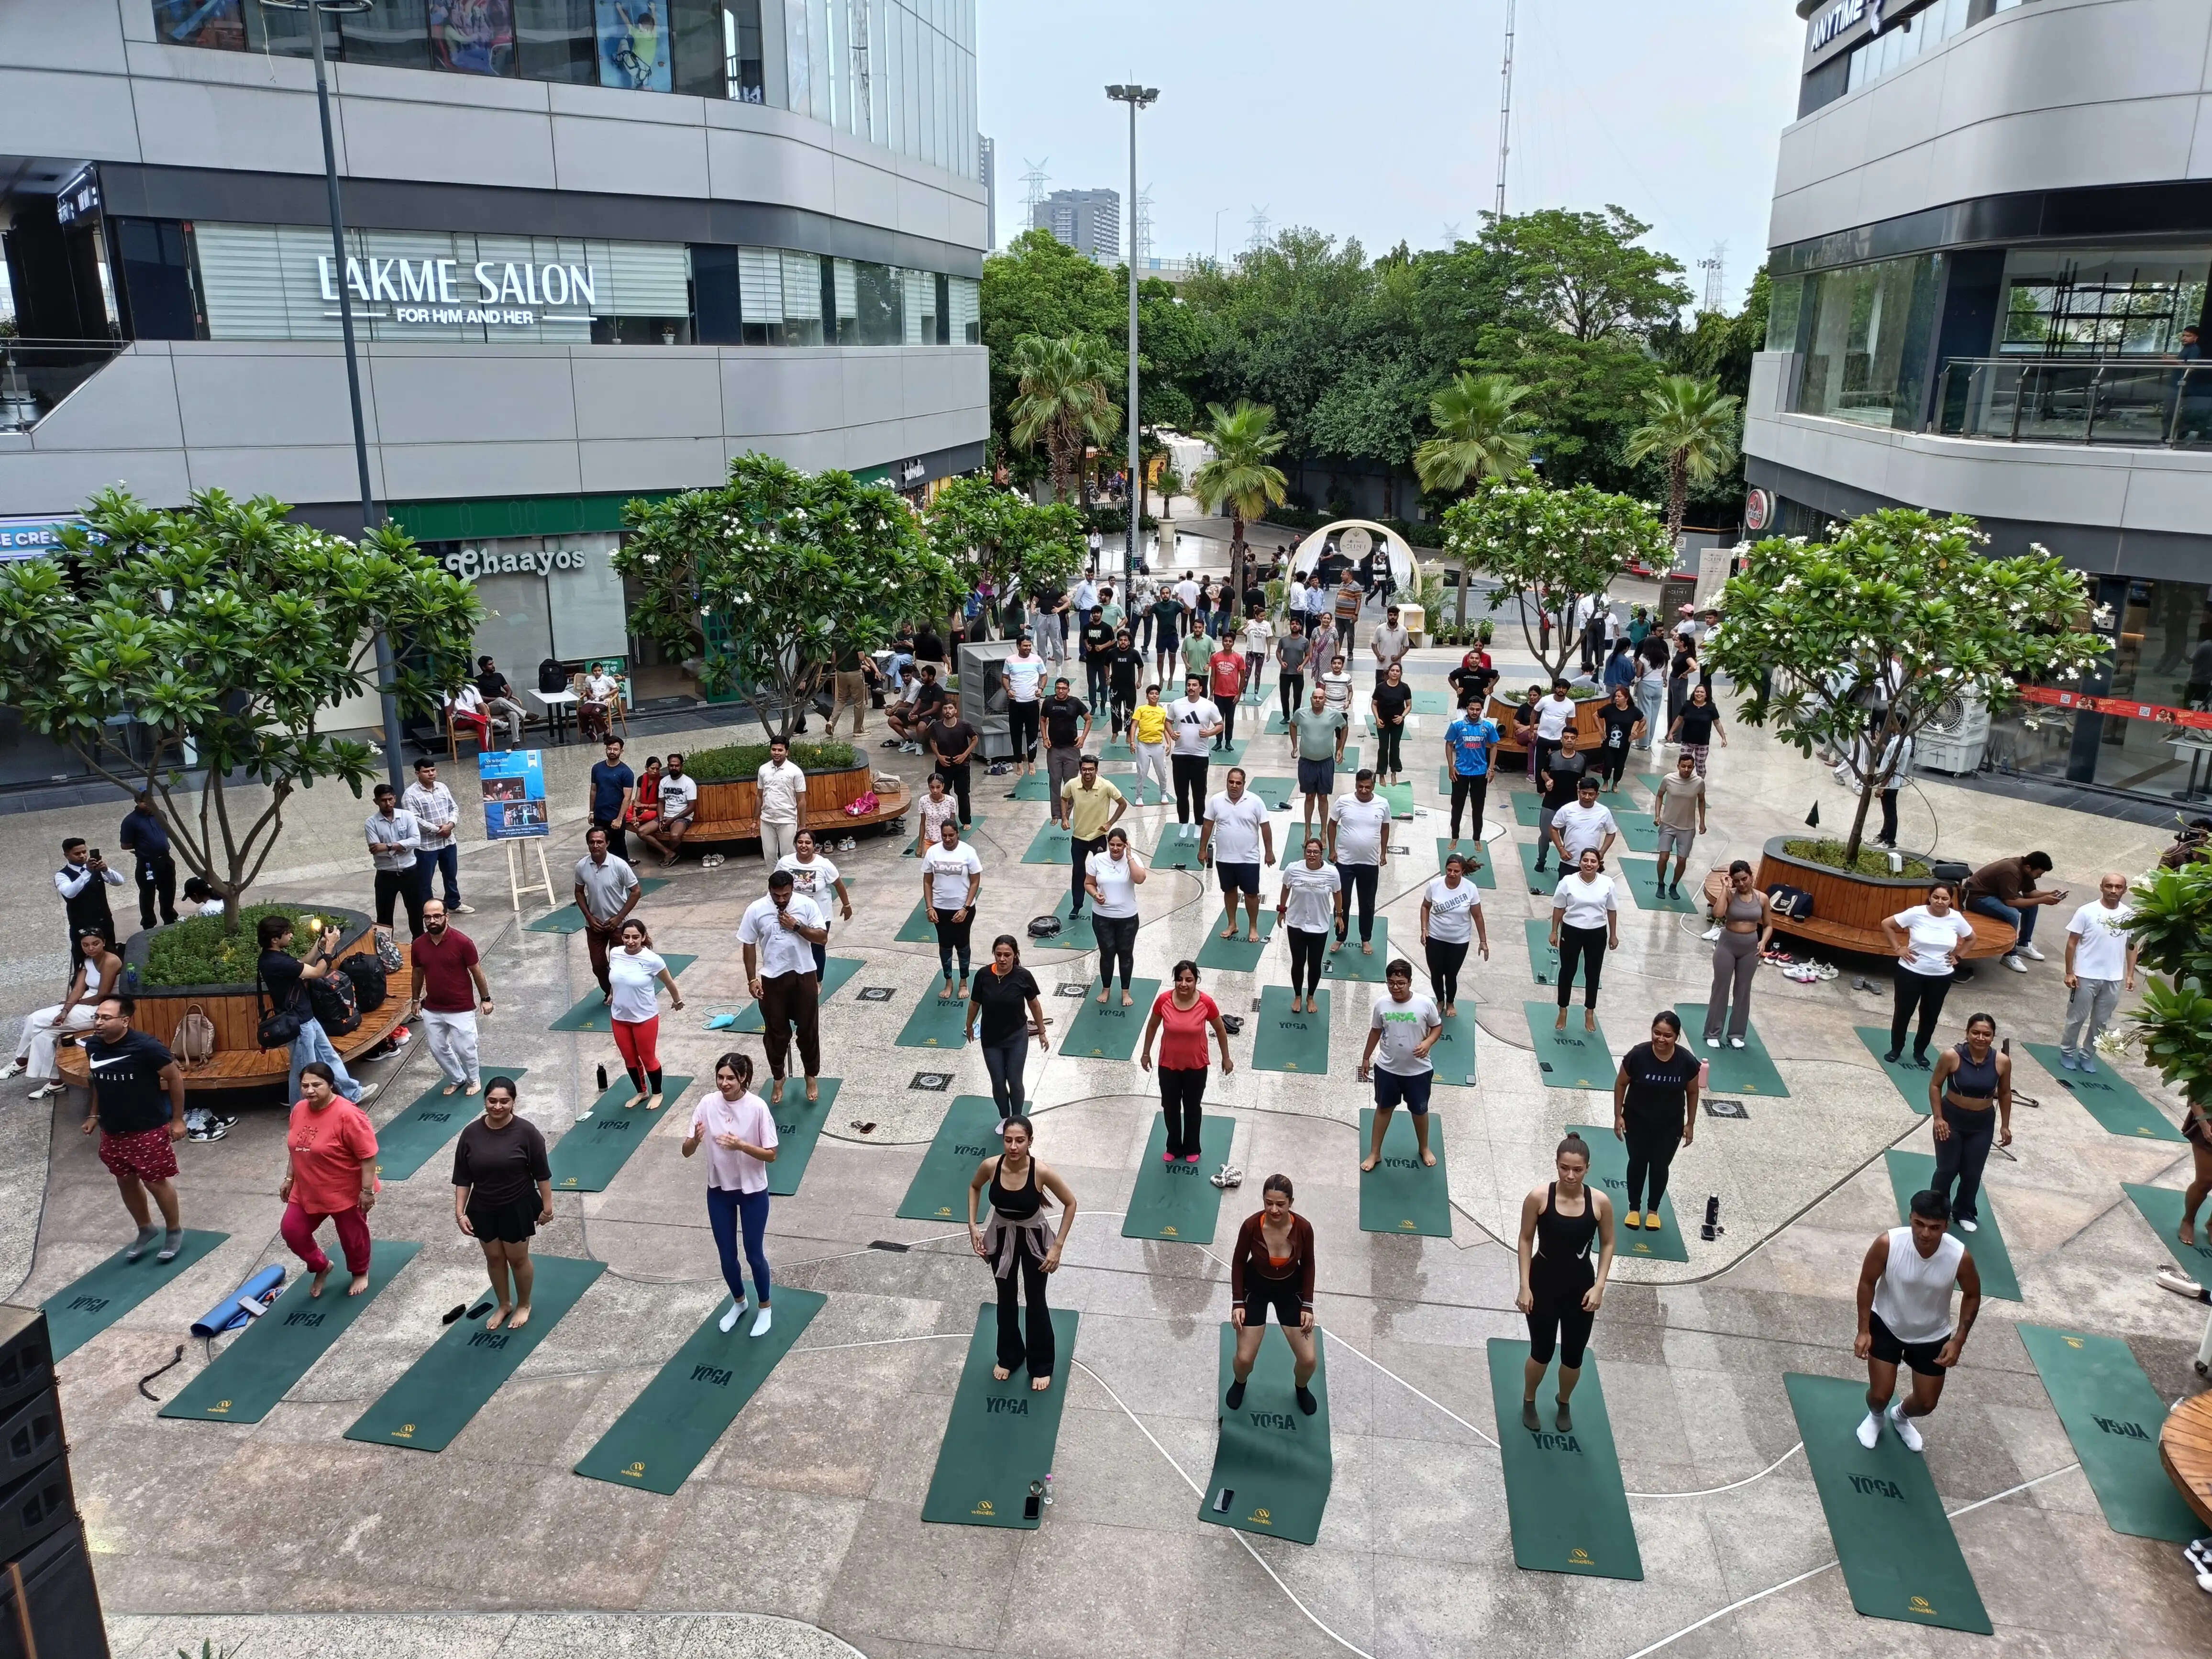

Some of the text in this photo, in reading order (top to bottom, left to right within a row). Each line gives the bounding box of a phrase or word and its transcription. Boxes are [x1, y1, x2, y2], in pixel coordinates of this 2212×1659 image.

[1811, 0, 1863, 52] ANYTIME
[318, 256, 596, 305] LAKME SALON
[397, 308, 533, 325] FOR HIM AND HER
[445, 547, 586, 580] Chaayos
[1433, 896, 1468, 913] STRONGER
[1099, 1009, 1126, 1018] YOGA
[1279, 1022, 1307, 1030] YOGA
[1554, 1038, 1584, 1047] YOGA
[1646, 1073, 1681, 1082] #HUSTLE
[2078, 1080, 2114, 1091] YOGA
[417, 1113, 451, 1122] YOGA
[597, 1121, 630, 1130] YOGA
[954, 1145, 986, 1157] YOGA
[1165, 1165, 1199, 1175] YOGA
[1384, 1158, 1419, 1169] YOGA
[1603, 1178, 1627, 1189] YOG
[66, 1296, 110, 1312] YOGA
[283, 1313, 326, 1327] YOGA
[466, 1332, 510, 1349] YOGA
[689, 1365, 733, 1386] YOGA
[986, 1397, 1029, 1415] YOGA
[1250, 1413, 1296, 1430] YOGA
[2092, 1416, 2150, 1439] YOGA
[1531, 1433, 1582, 1453] YOGA
[1847, 1475, 1904, 1499] YOGA
[1248, 1516, 1272, 1525] wiselife
[1908, 1606, 1937, 1615] wiselife
